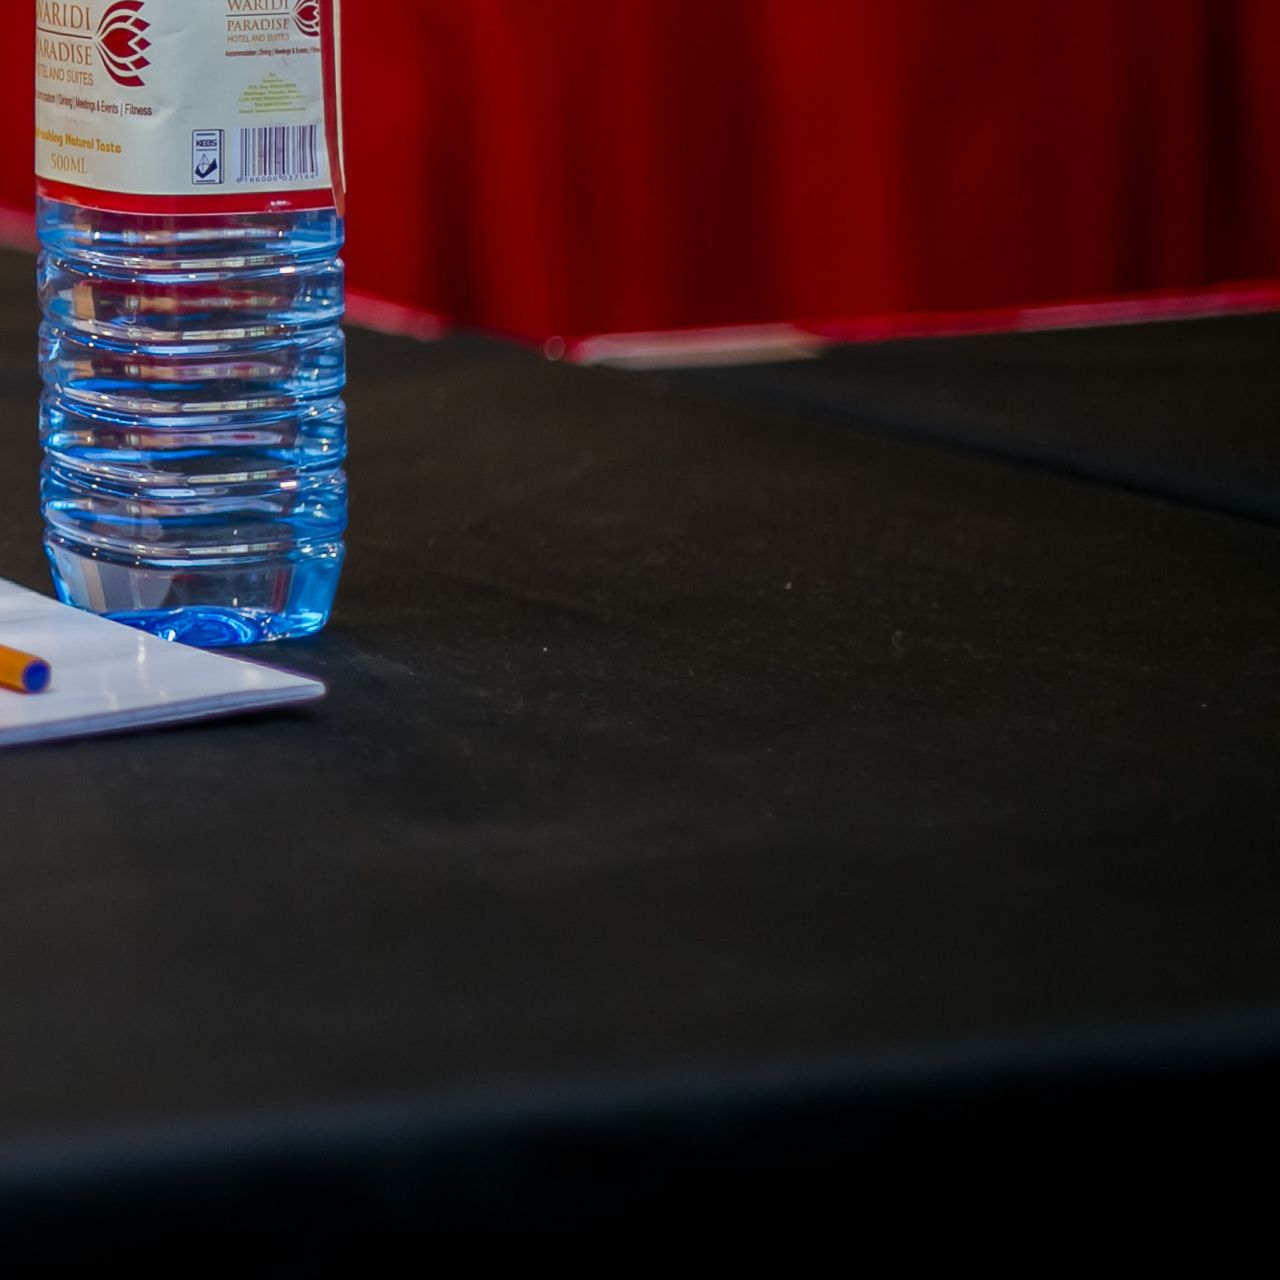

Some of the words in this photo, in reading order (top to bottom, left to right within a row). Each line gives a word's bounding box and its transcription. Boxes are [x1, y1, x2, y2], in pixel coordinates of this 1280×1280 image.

[227, 18, 289, 32] PARADISE
[227, 34, 249, 43] HOTEL
[251, 33, 265, 42] AND
[37, 38, 92, 66] ARADISE
[49, 66, 65, 81] AND
[67, 70, 94, 87] SUITES
[101, 101, 119, 114] Events
[124, 103, 152, 116] Fitness
[65, 133, 93, 150] Natural
[96, 139, 122, 153] Taste
[50, 153, 87, 174] 500ML
